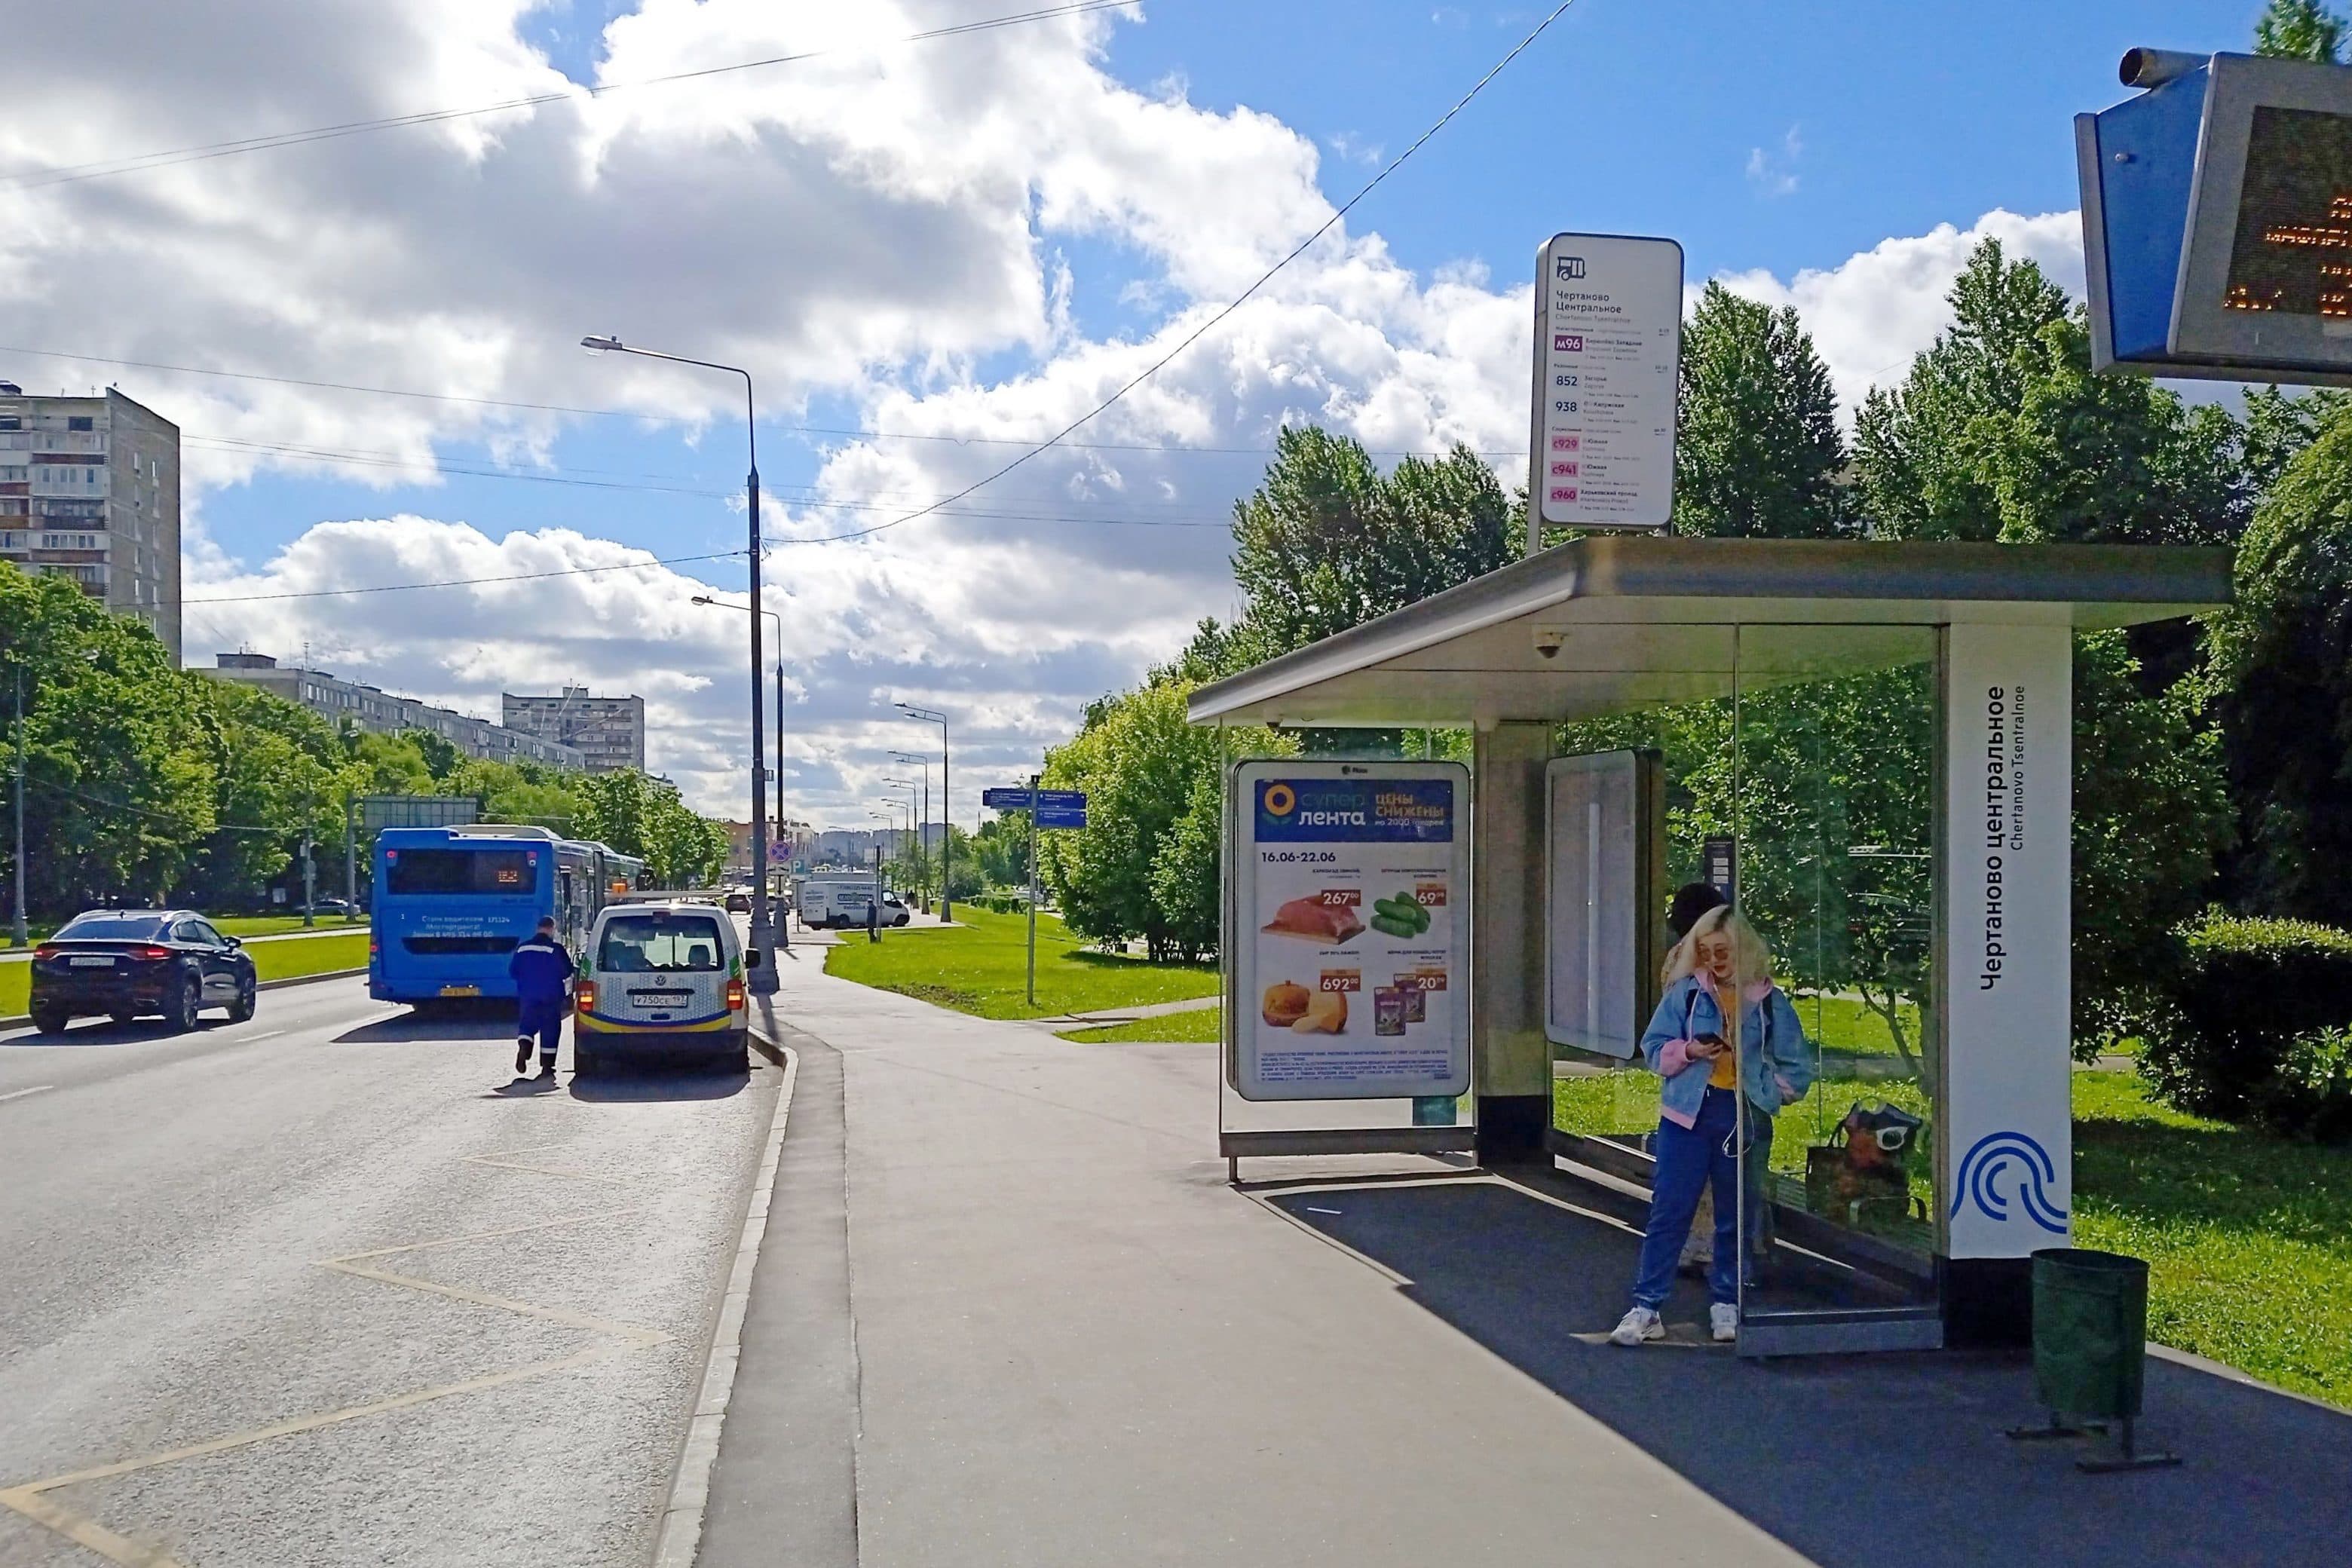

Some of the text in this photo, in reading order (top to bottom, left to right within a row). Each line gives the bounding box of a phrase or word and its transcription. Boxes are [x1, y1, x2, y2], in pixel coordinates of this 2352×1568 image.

[1556, 290, 1609, 302] Чертаново
[1556, 302, 1622, 314] Центральное
[1556, 375, 1578, 386] 852
[1555, 401, 1577, 412] 938
[2011, 686, 2025, 851] Chertanovo Tsentralnoe
[1375, 794, 1413, 805] ЦЕНЫ
[1375, 806, 1444, 817] СНИЖЕНЫ
[1298, 812, 1366, 825] лента
[1261, 852, 1337, 862] 16.06-22.06
[1323, 892, 1350, 905] 267
[1418, 892, 1436, 904] 69
[1980, 856, 2007, 991] Чертаново
[1322, 978, 1350, 990] 692
[1417, 977, 1436, 989] 20
